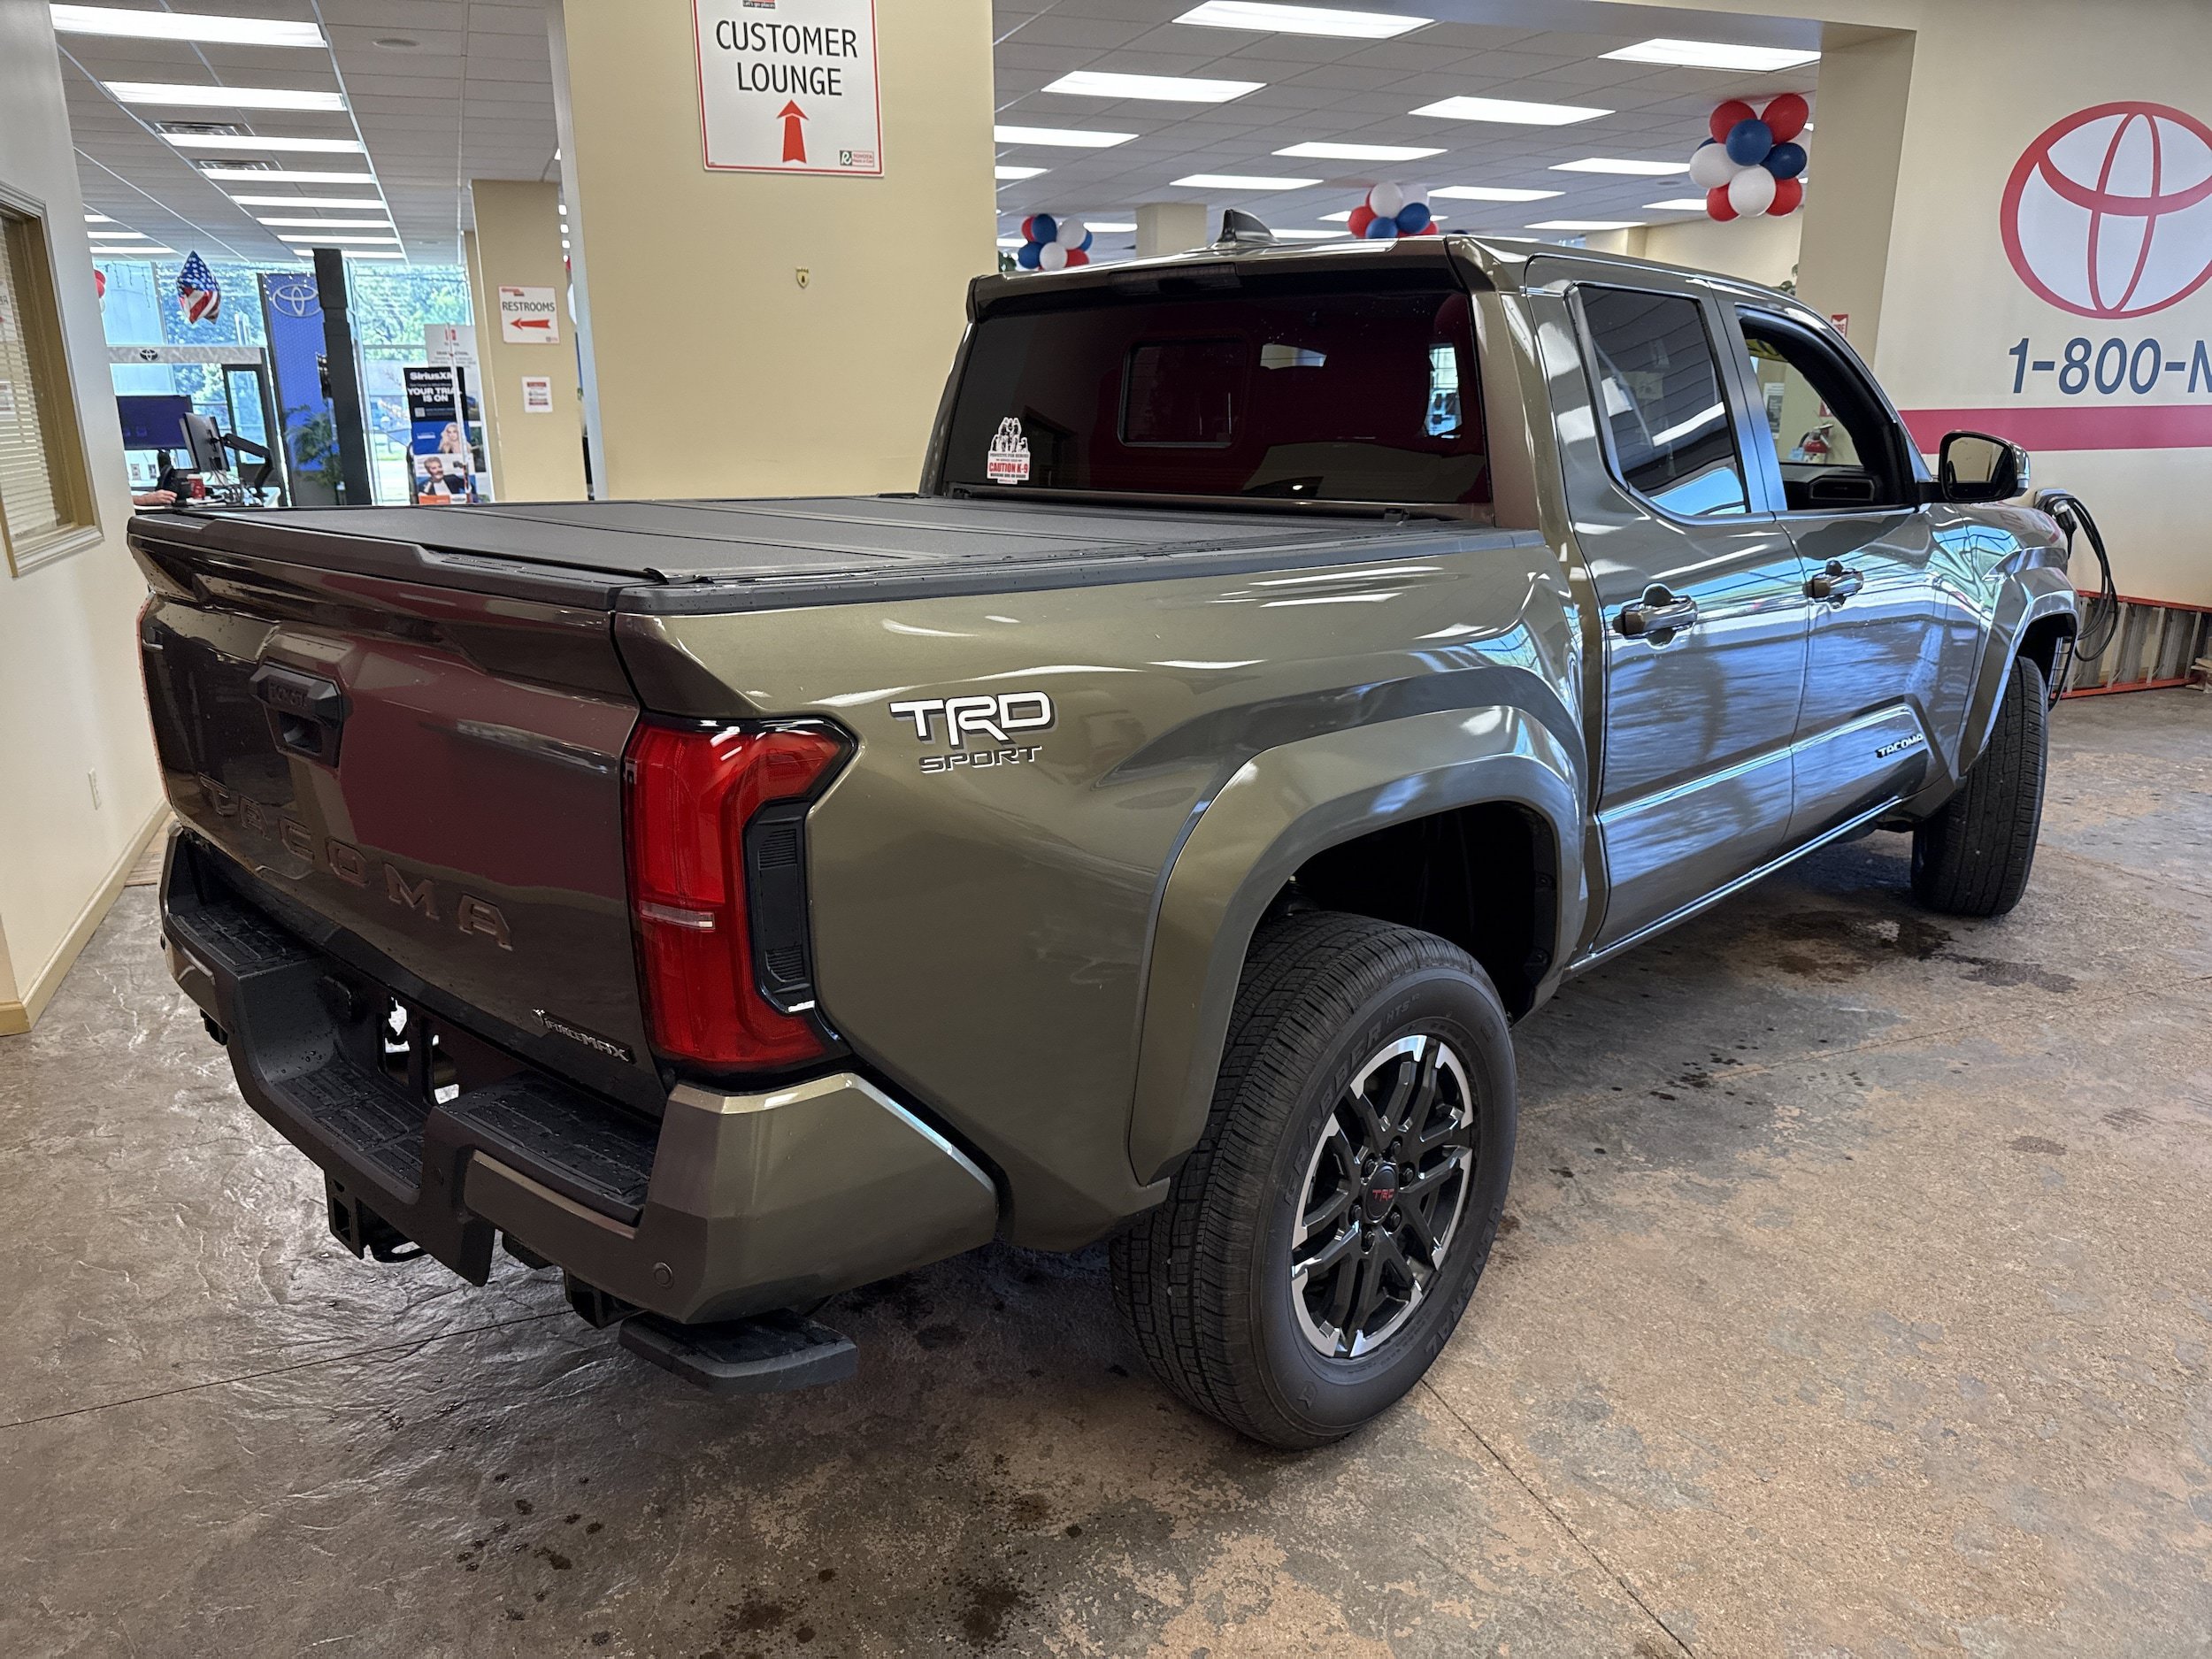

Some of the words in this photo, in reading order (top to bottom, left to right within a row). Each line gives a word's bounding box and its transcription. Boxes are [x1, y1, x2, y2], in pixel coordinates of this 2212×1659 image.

[716, 20, 858, 58] CUSTOMER
[737, 62, 842, 96] LOUNGE
[502, 302, 555, 312] RESTROOMS
[989, 462, 1016, 472] CAUTION
[1017, 463, 1029, 474] K-9
[888, 690, 1056, 749] TRD
[918, 746, 1042, 773] SPORT
[1876, 733, 1924, 758] TACOMA
[198, 775, 513, 951] TACOMA
[580, 1033, 629, 1062] MAX
[1284, 1019, 1382, 1207] GRABBER
[1425, 1202, 1501, 1356] GENERAL
